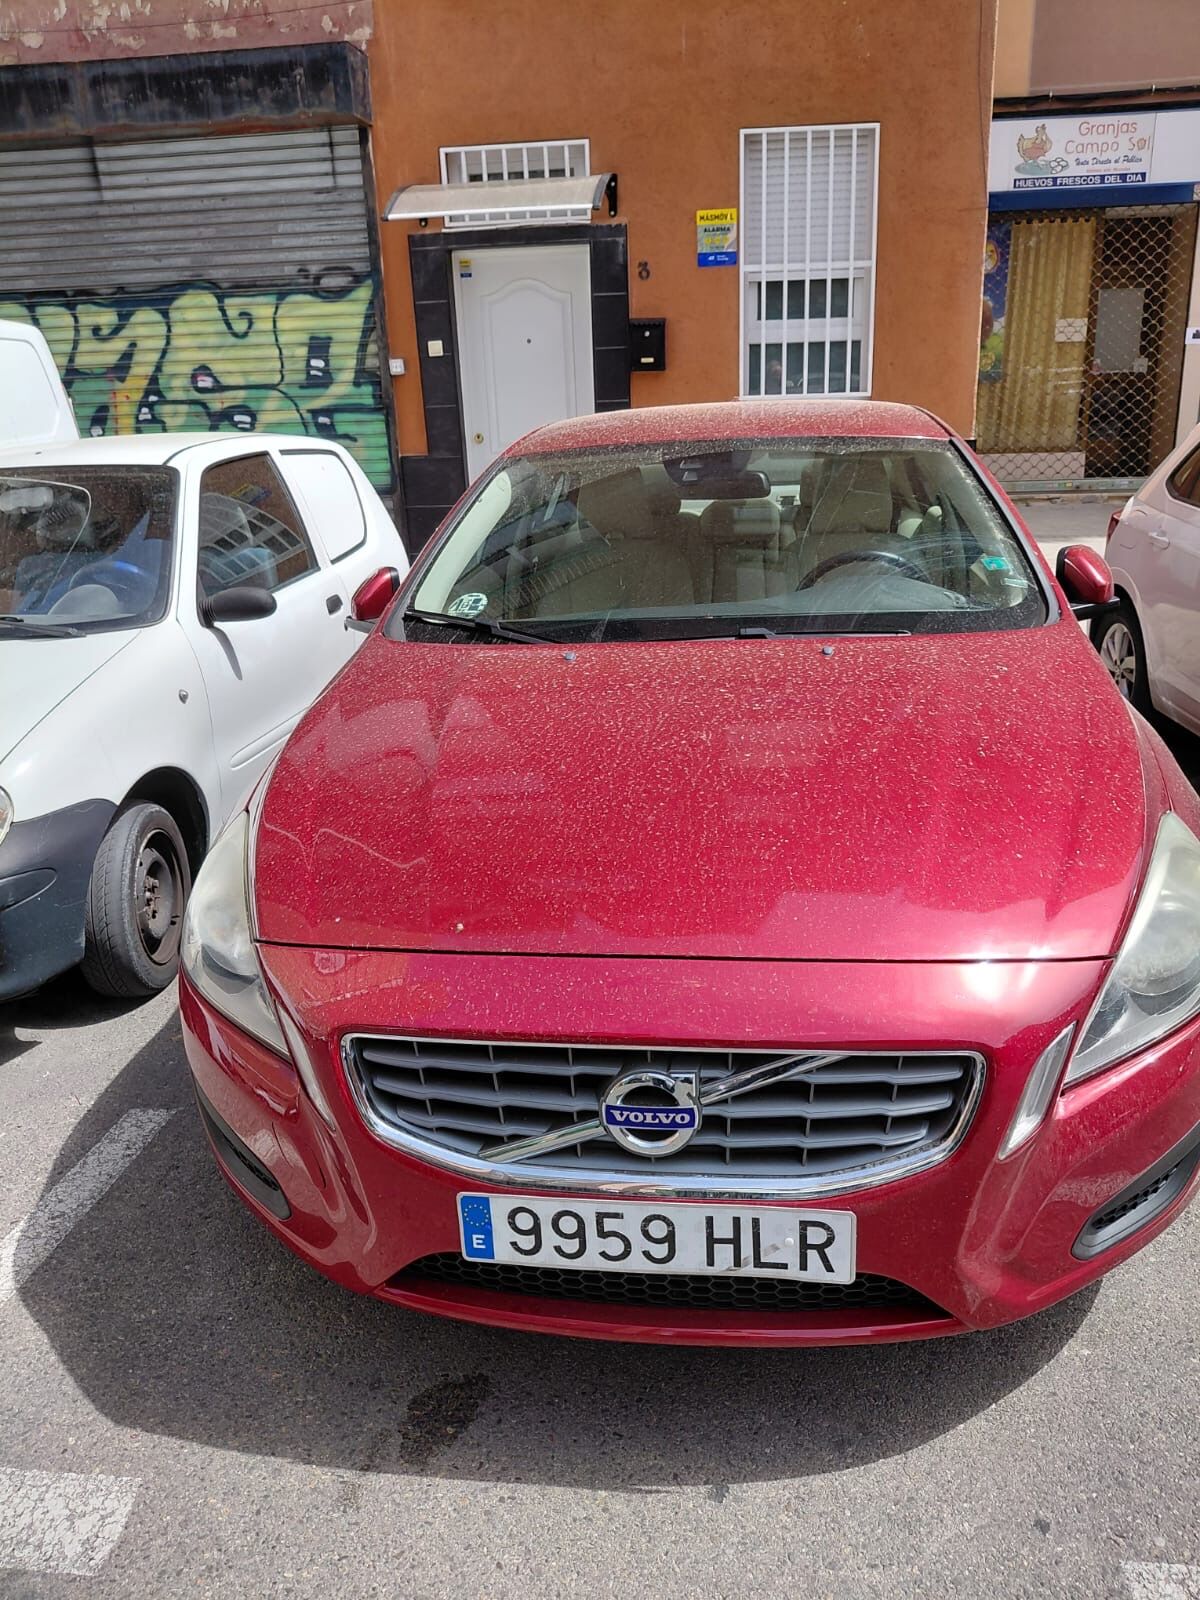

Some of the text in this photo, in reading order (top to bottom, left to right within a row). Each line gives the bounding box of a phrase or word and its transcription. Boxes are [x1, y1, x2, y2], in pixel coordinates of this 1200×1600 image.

[1078, 120, 1138, 138] Granjas
[1064, 135, 1151, 156] Campo Sol
[1015, 178, 1053, 188] HUEVOS
[1056, 176, 1100, 186] FRESCOS
[1104, 175, 1122, 184] DEL
[610, 1109, 690, 1124] VOLVO
[472, 1234, 486, 1249] E
[506, 1206, 836, 1273] 9959 HLR
